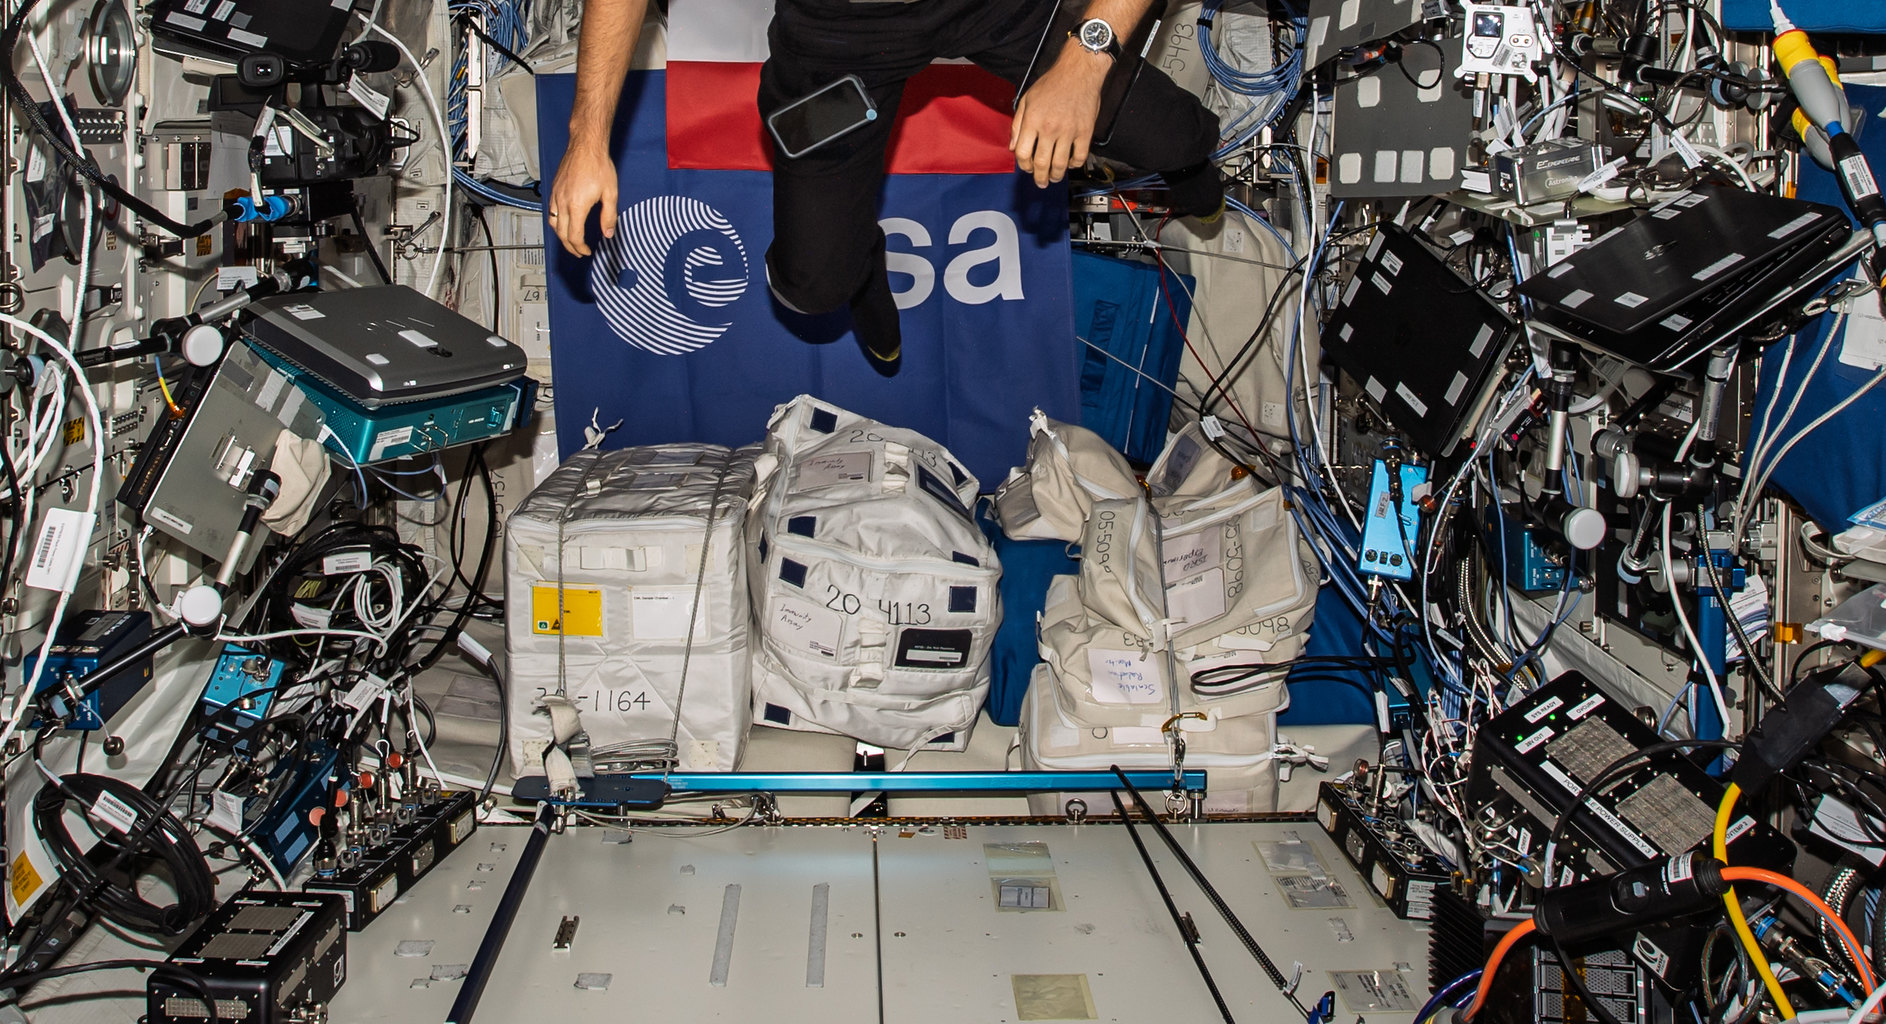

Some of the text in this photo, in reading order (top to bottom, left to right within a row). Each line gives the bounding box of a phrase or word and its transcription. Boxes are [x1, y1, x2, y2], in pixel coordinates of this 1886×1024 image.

[849, 429, 885, 443] 20
[826, 584, 932, 625] 20 4113
[1530, 701, 1557, 719] SYS READY
[1598, 805, 1621, 829] POWER
[1620, 826, 1646, 851] SUPPLY
